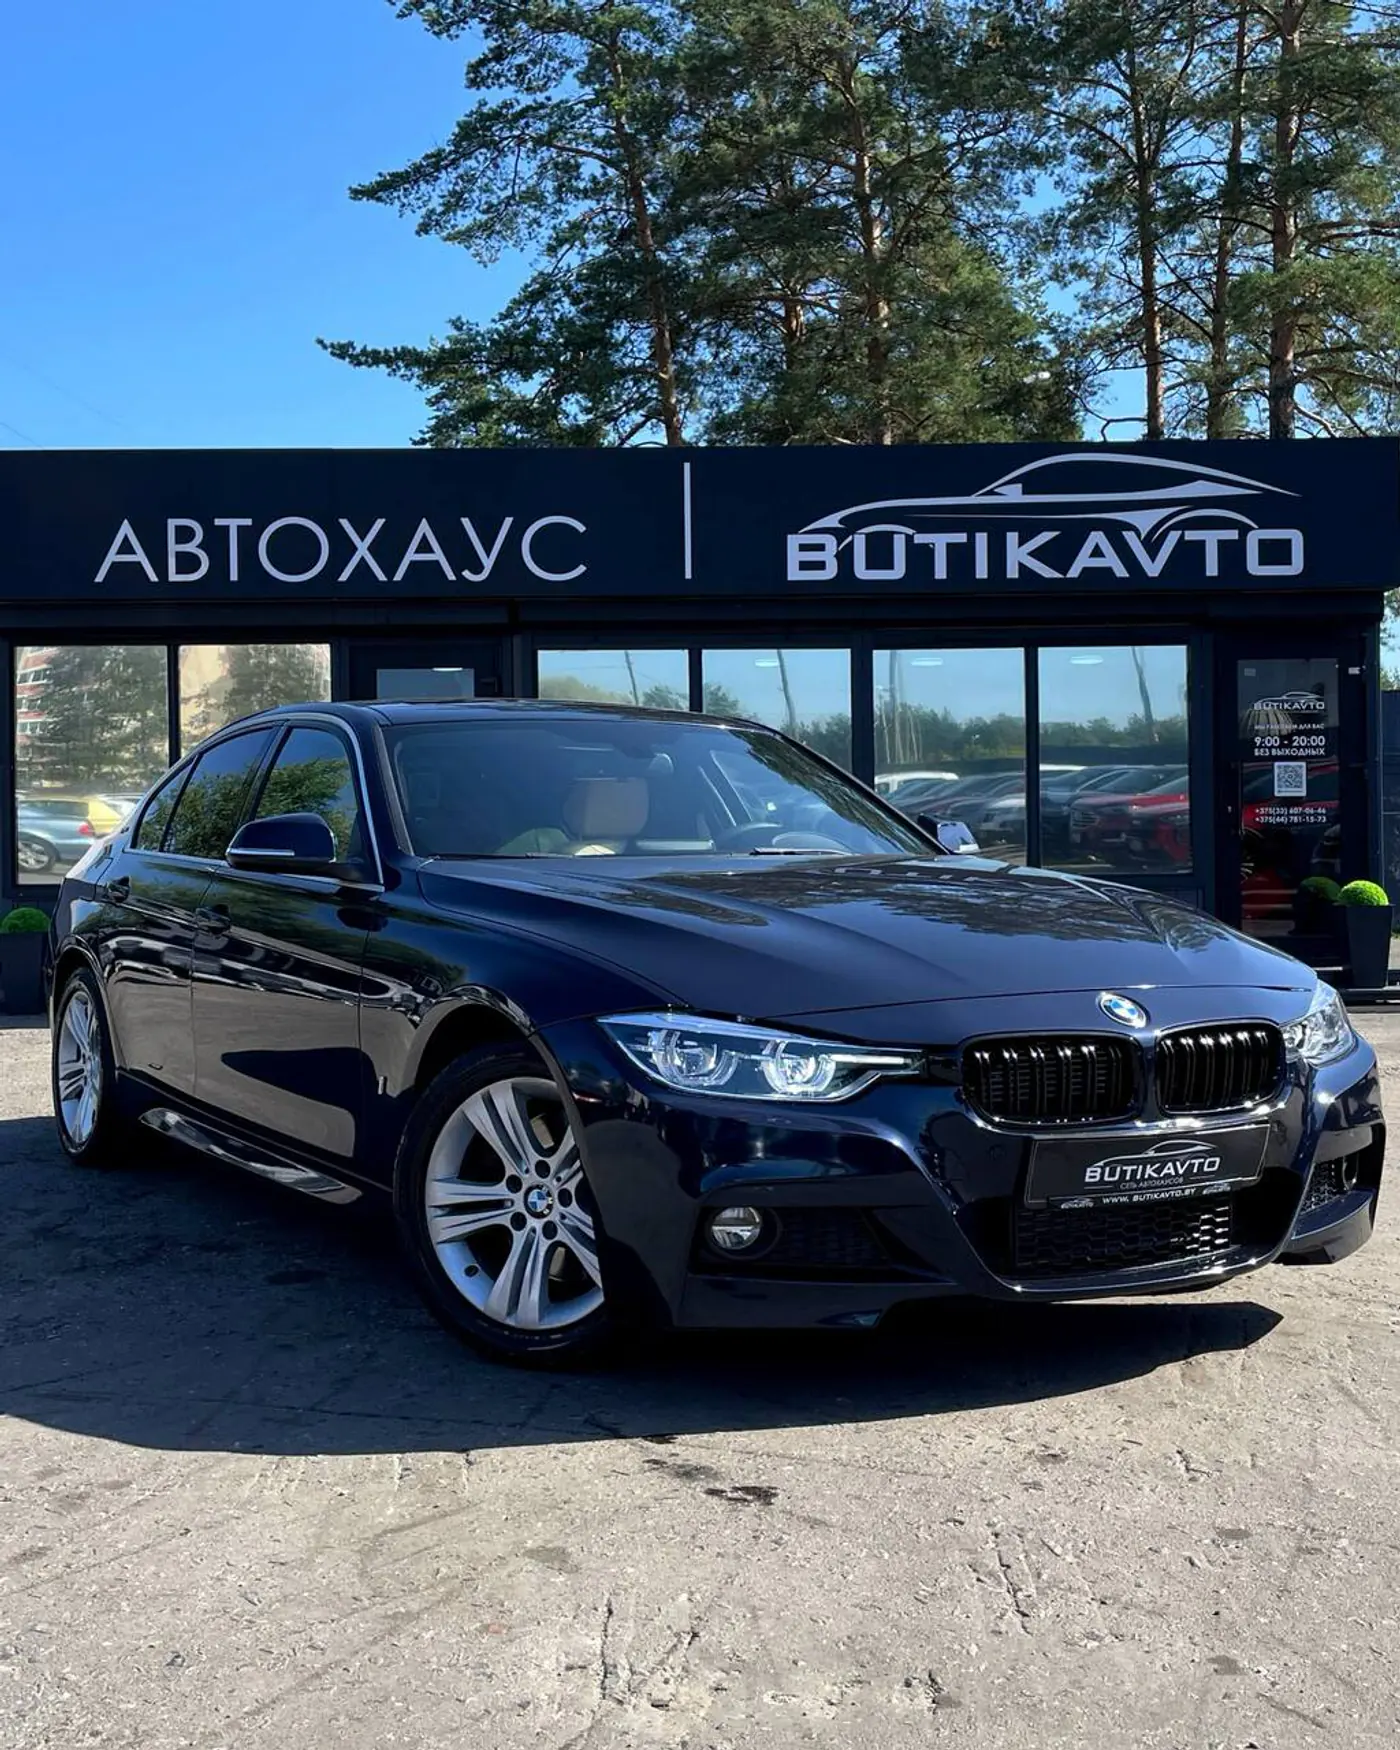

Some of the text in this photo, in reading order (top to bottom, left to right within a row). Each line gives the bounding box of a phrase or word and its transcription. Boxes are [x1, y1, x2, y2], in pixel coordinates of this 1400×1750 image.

[94, 515, 588, 583] АВТОХАУС
[786, 528, 1305, 581] BUTIKAVTO
[1253, 701, 1325, 711] BUTIKAVTO
[1254, 735, 1280, 747] 9:00
[1292, 735, 1326, 747] 20:00
[1254, 747, 1326, 757] БЕЗ ВЫХОДНЫХ
[1084, 1157, 1221, 1183] BUTIKAVTO
